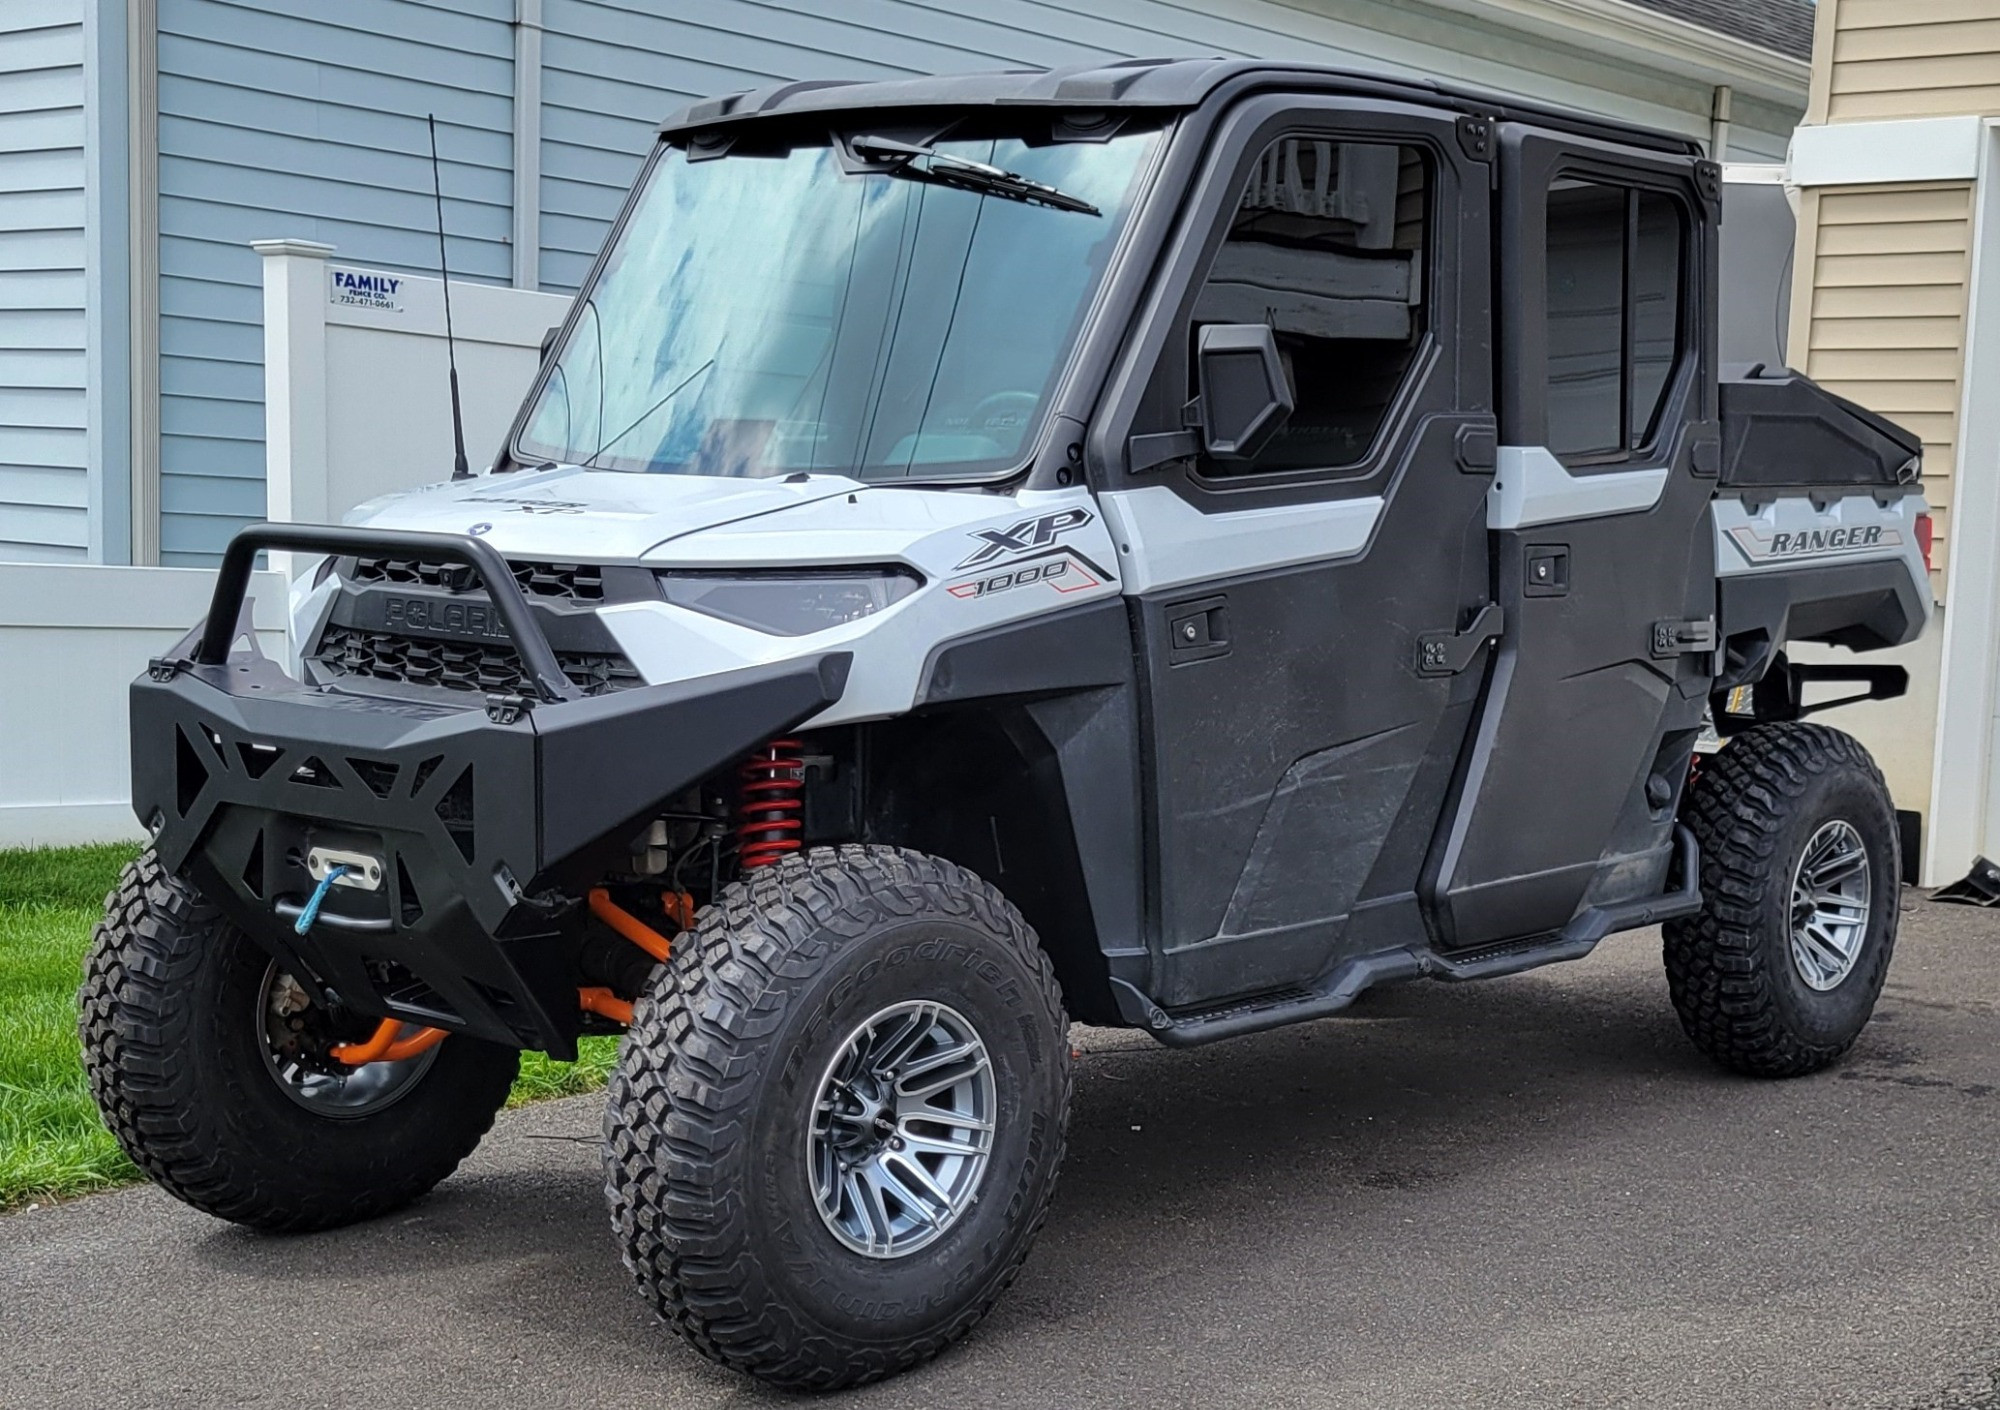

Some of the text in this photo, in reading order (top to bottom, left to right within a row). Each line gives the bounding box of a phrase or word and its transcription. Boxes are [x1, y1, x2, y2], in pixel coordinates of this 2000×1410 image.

[335, 272, 399, 294] FAMILY
[349, 289, 371, 298] FENCE
[340, 295, 394, 309] 732-471-0661
[951, 506, 1095, 571] XP
[1768, 525, 1882, 556] RANGER
[974, 558, 1069, 598] 1000
